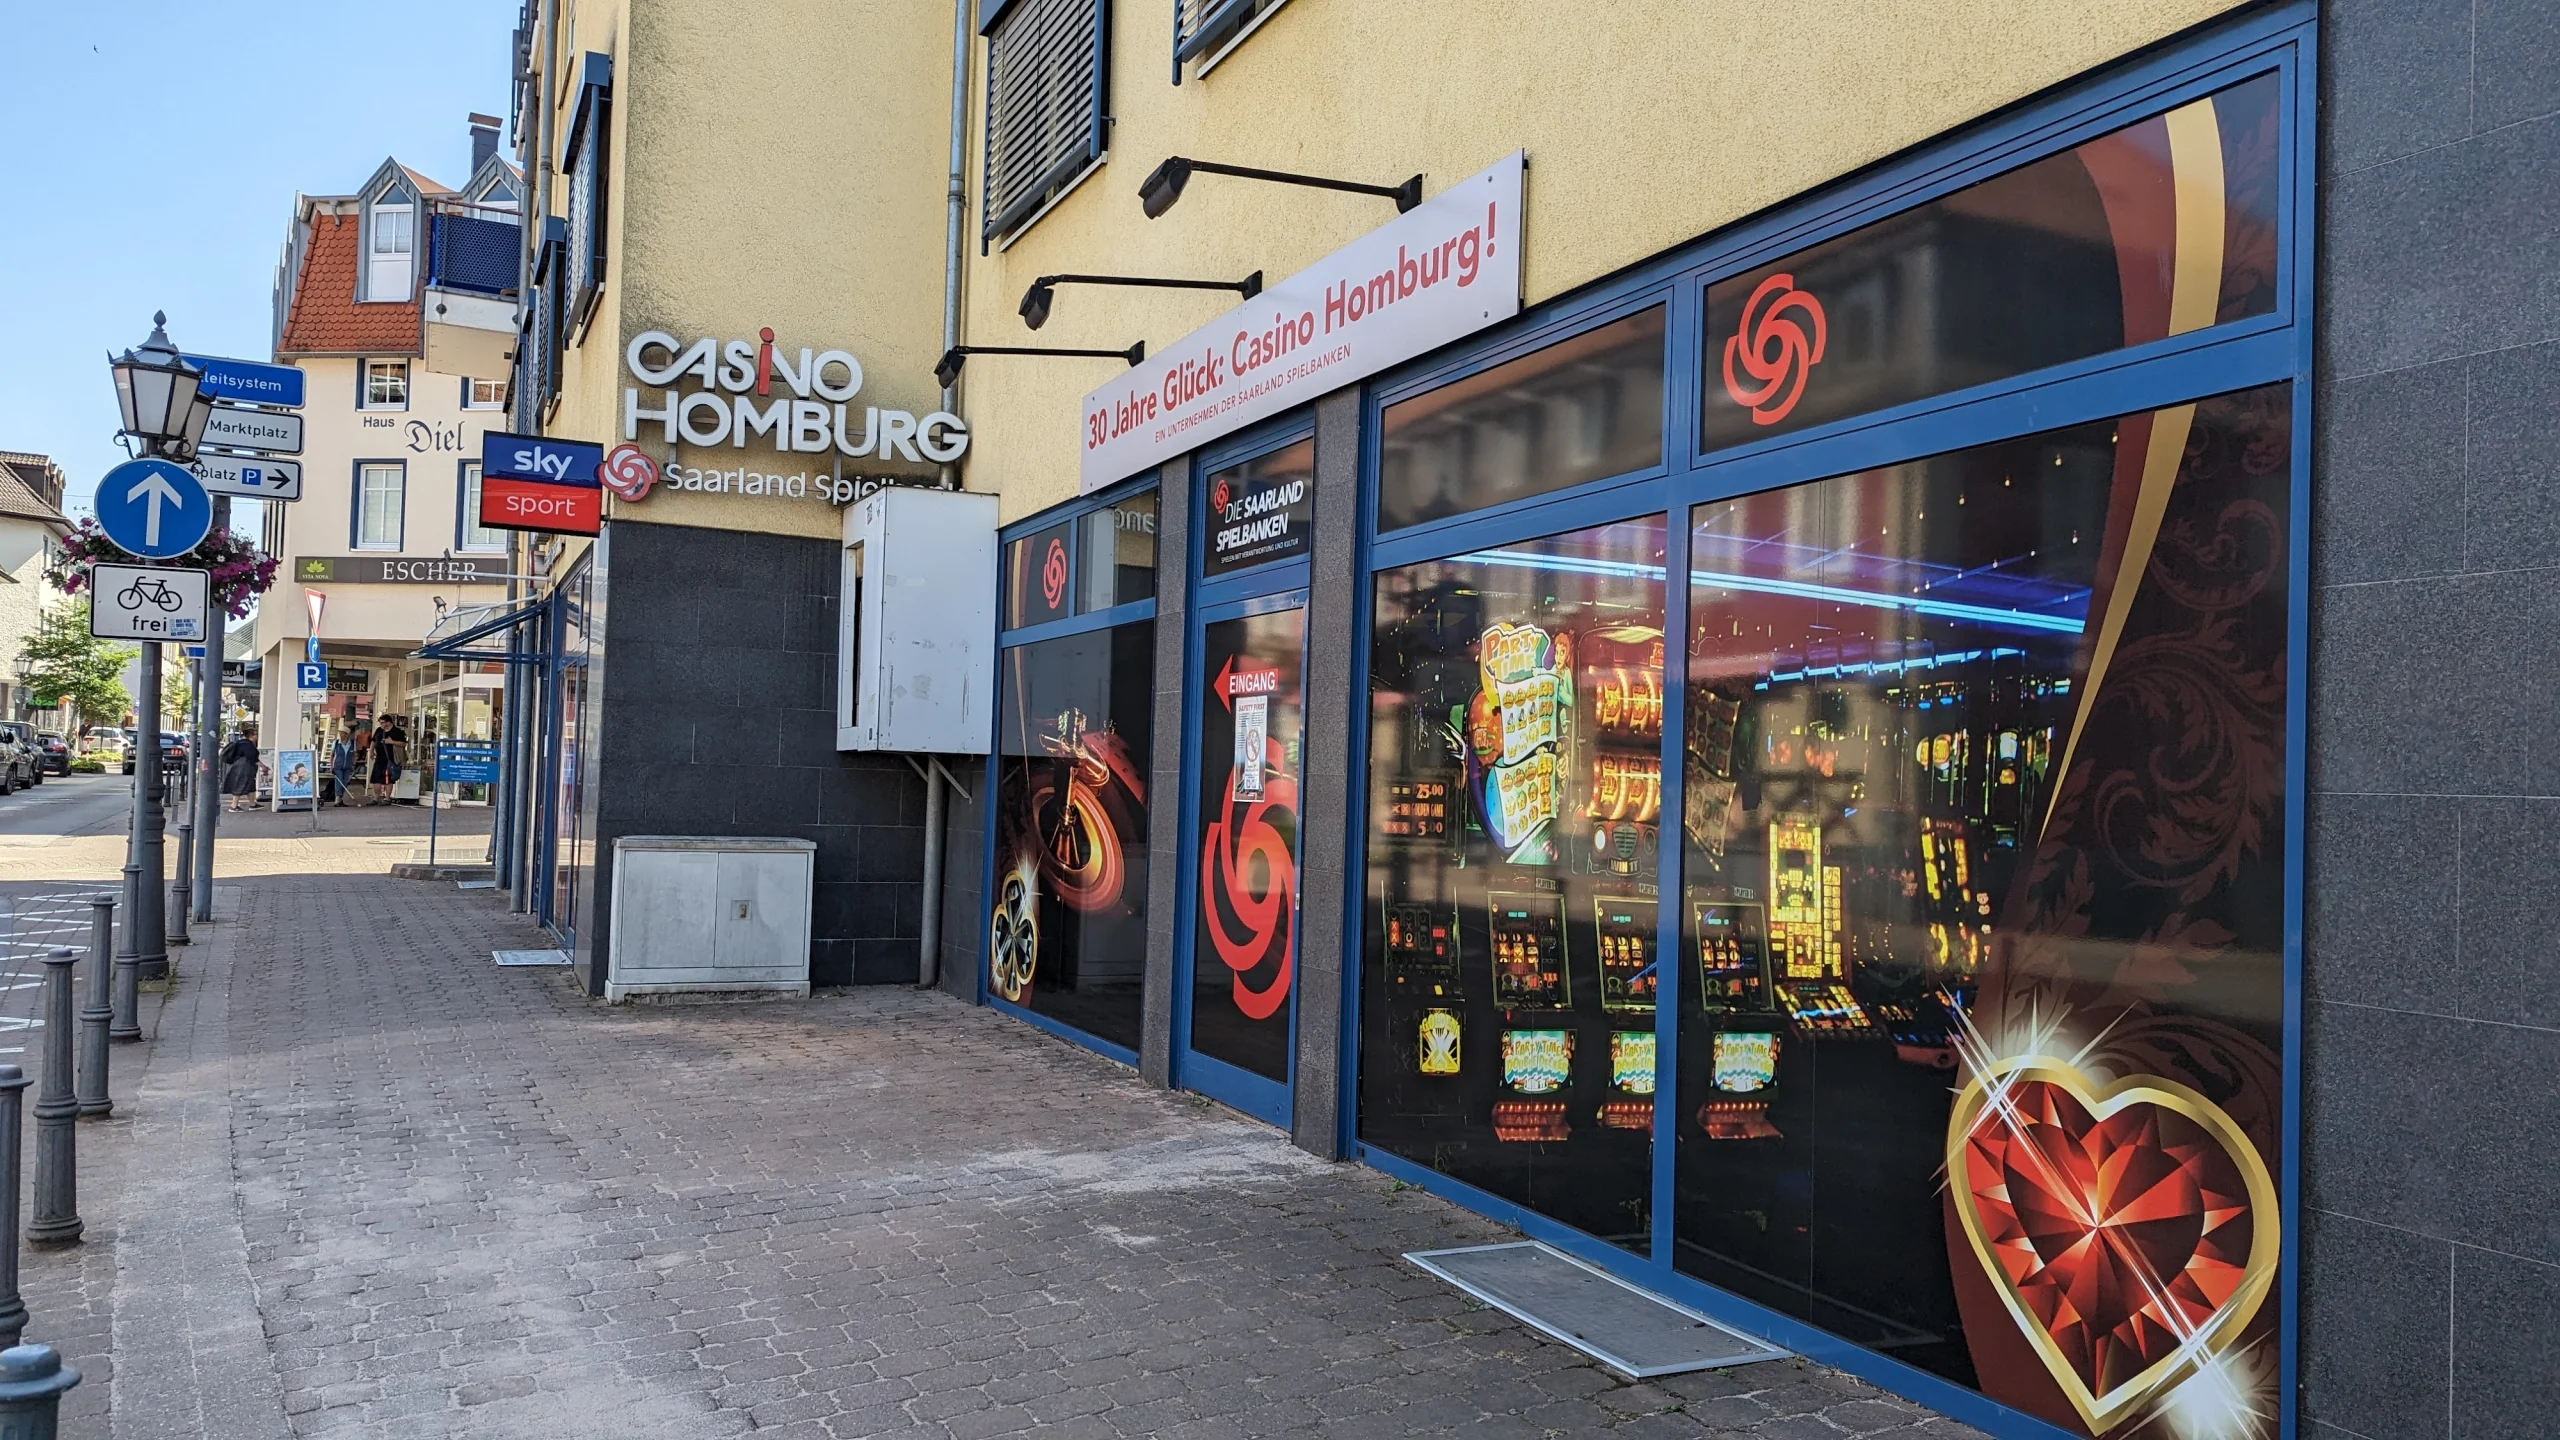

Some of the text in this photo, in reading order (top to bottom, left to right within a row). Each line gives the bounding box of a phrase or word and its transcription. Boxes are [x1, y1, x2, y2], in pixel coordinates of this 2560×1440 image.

[1089, 201, 1496, 450] 30 Jahre Glück: Casino Homburg!
[201, 371, 282, 391] leitsystem
[1155, 343, 1351, 443] EIN UNTERNEHMEN DER SAARLAND SPIELBANKEN
[210, 420, 288, 439] Marktplatz
[363, 416, 465, 453] Haus Diel
[625, 388, 969, 463] HOMBURG
[514, 446, 573, 480] sky
[665, 463, 806, 498] Saarland
[506, 495, 576, 517] sport
[1225, 480, 1304, 523] DIE SAARLAND
[1216, 512, 1289, 552] SPIELBANKEN
[382, 560, 477, 581] ESCHER
[132, 616, 167, 632] frei
[1485, 632, 1540, 662] PARTY
[327, 681, 366, 692] SCHER
[1229, 671, 1276, 693] EINGANG
[1611, 860, 1628, 873] WIN
